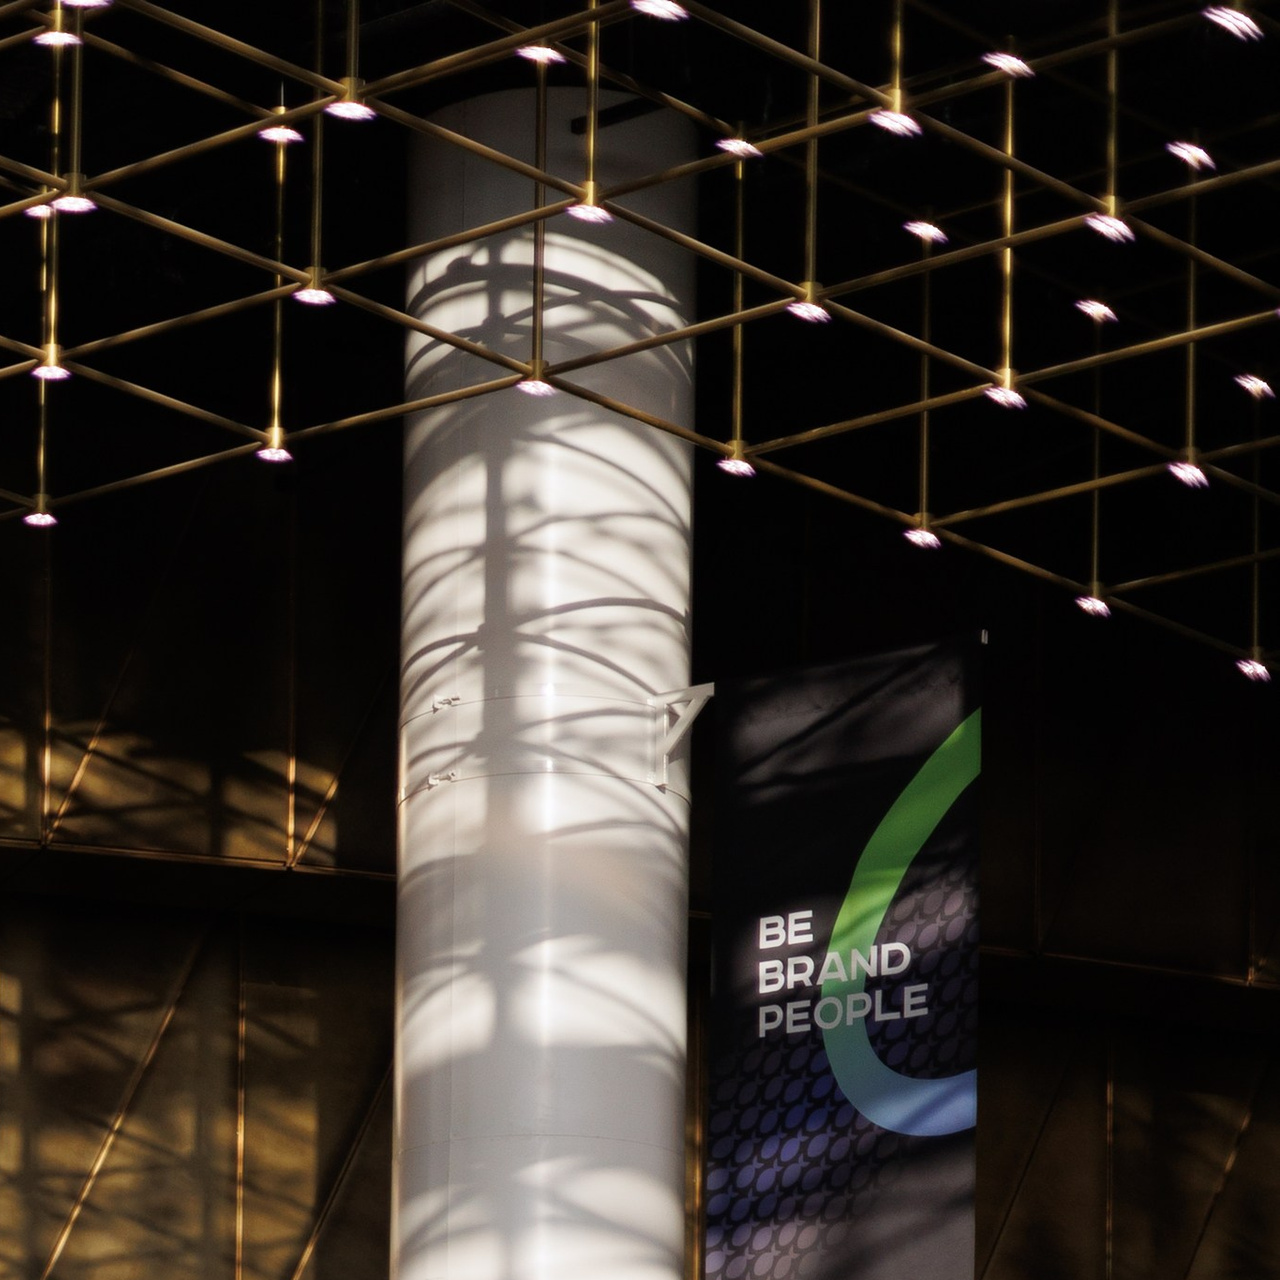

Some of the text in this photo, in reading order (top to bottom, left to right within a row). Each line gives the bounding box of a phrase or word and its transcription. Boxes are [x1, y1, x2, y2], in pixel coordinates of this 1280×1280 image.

[758, 909, 814, 950] BE
[758, 941, 912, 995] BRAND
[758, 982, 929, 1039] PEOPLE
